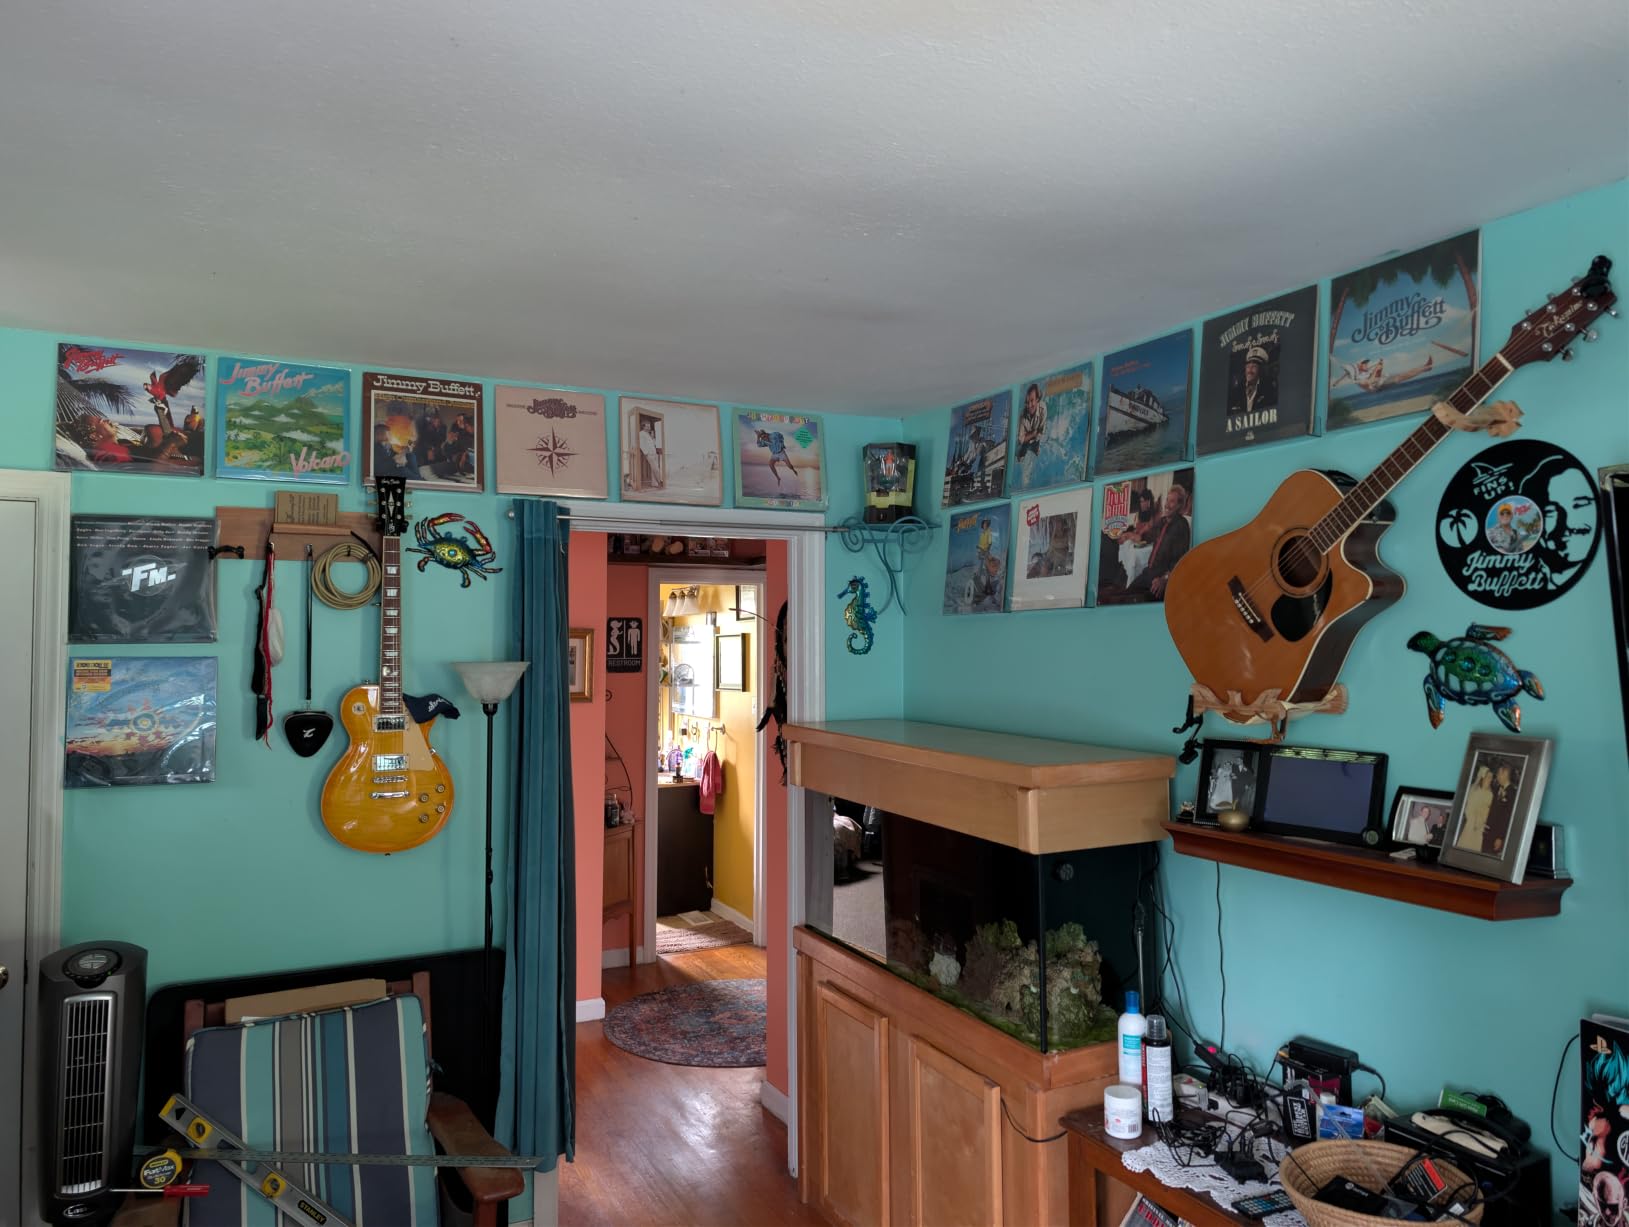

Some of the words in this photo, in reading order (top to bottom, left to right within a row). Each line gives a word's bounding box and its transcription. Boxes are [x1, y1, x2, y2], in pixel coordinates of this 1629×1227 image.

[1252, 311, 1295, 328] BUFFETT
[1351, 292, 1421, 343] Jimmy
[1367, 296, 1446, 345] Buffett
[220, 362, 280, 384] Jimmy
[240, 369, 315, 397] Buffett
[373, 375, 427, 393] Jimmy
[428, 381, 475, 396] Buffett
[1225, 418, 1233, 433] A
[1235, 408, 1278, 431] SAILOR
[290, 447, 352, 480] Volcano
[1473, 476, 1508, 496] FINS
[1462, 550, 1535, 577] Jimmy
[130, 563, 169, 593] FM
[1467, 567, 1544, 598] Buffett
[608, 658, 642, 668] RESTROOM
[154, 1176, 166, 1184] 30
[299, 1201, 326, 1223] STANLEY
